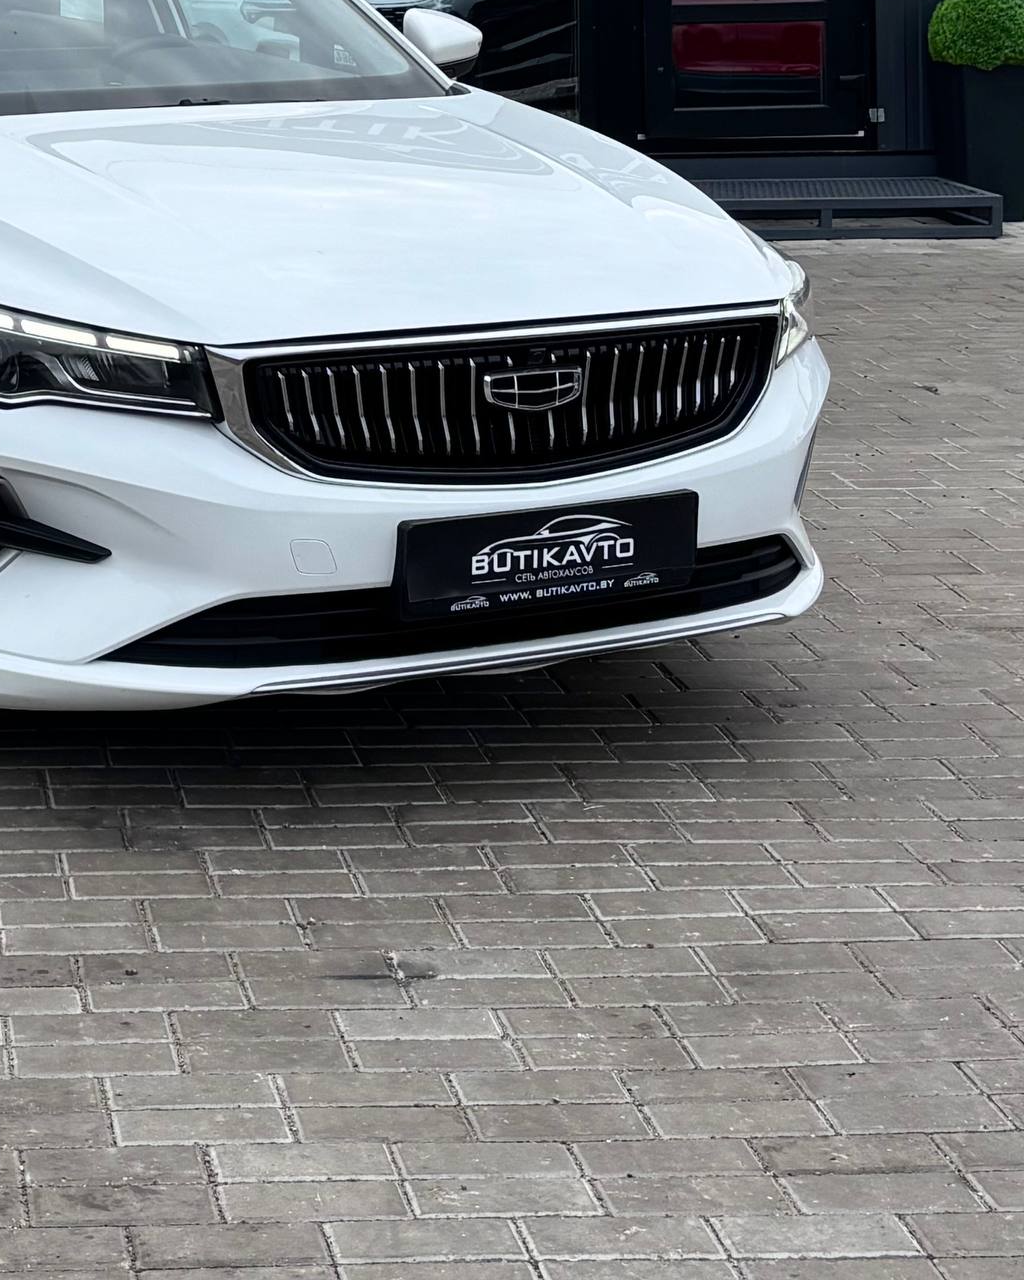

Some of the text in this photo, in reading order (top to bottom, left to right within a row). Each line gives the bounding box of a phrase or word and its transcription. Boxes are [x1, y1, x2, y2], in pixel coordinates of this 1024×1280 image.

[471, 538, 634, 576] BUTIKAVTO
[515, 565, 594, 583] СЕТЬ АВТОХАУСОВ
[536, 579, 615, 598] BUTIKAVTO.BY
